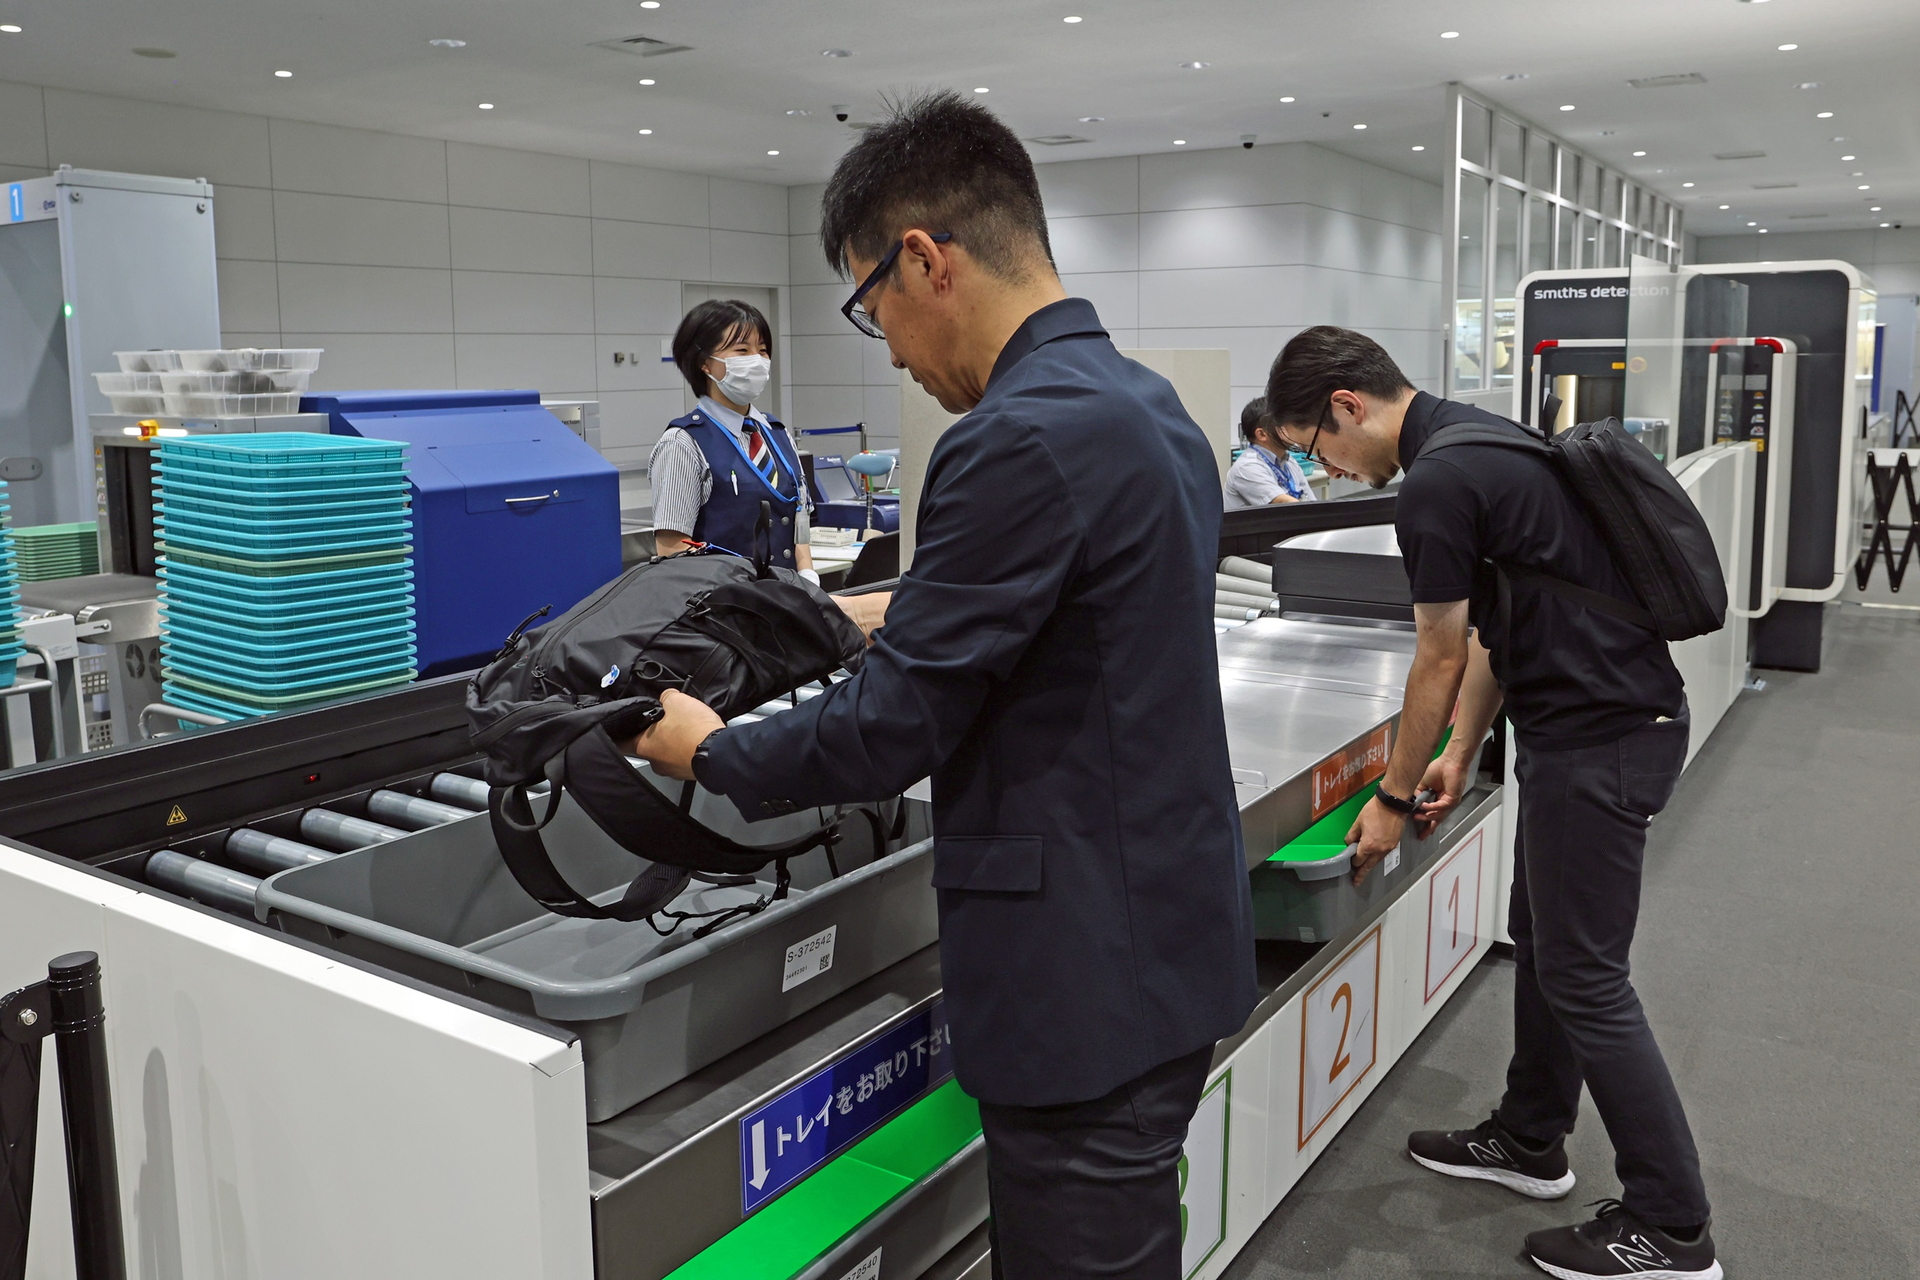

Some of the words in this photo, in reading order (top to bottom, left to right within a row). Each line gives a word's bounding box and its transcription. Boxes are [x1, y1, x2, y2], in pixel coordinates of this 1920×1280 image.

[12, 188, 20, 217] 1
[1534, 287, 1587, 299] smiths
[1448, 874, 1459, 950] 1
[786, 932, 832, 963] S-372542
[1328, 981, 1352, 1085] 2
[846, 1255, 878, 1280] 72540
